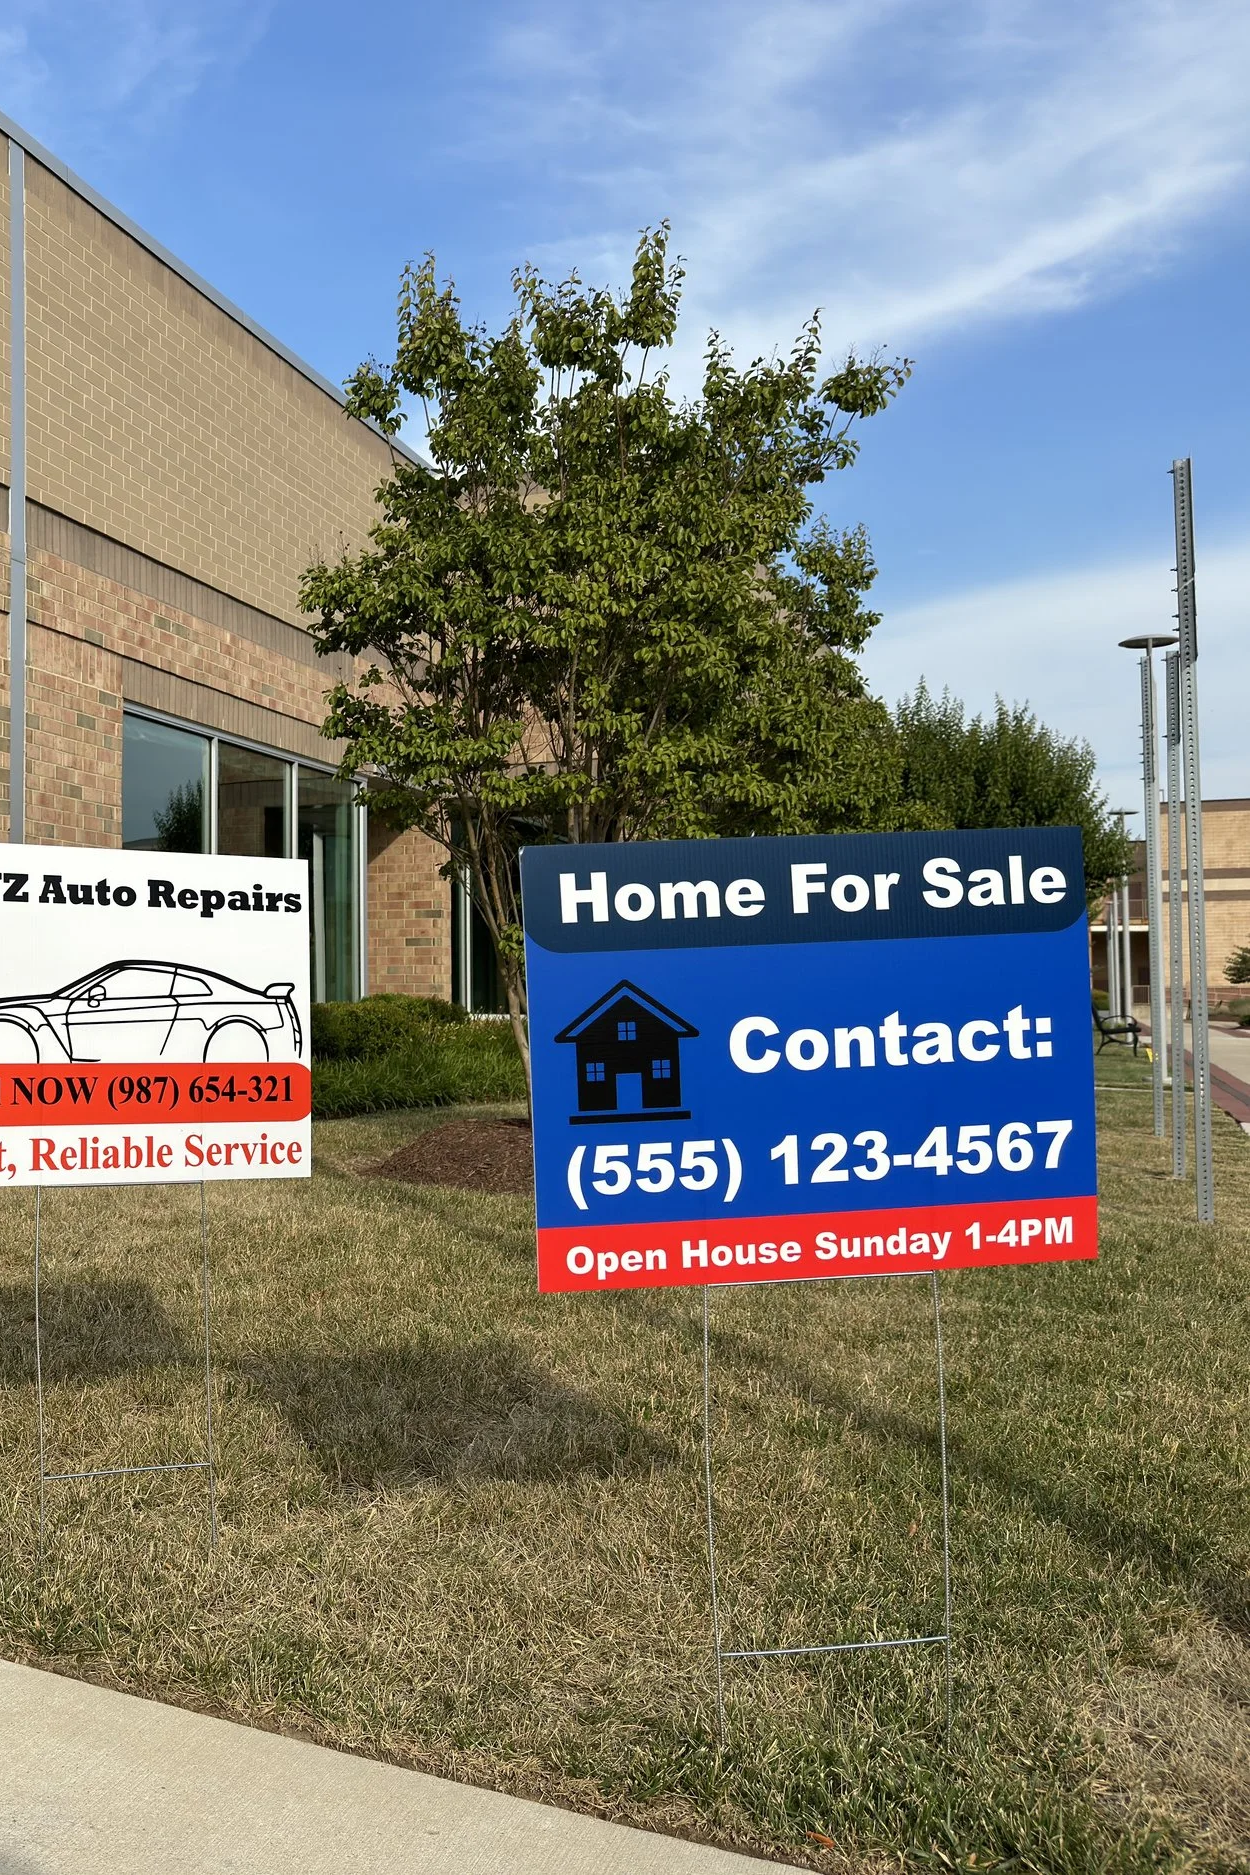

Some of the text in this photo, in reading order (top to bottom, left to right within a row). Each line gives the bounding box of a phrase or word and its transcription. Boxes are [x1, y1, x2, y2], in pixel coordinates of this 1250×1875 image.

[39, 875, 136, 906] Auto
[148, 880, 301, 918] Repairs
[560, 856, 1066, 923] Home For Sale
[730, 1005, 1052, 1073] Contact:
[12, 1078, 97, 1104] NOW
[108, 1077, 179, 1110] (987)
[189, 1076, 292, 1102] 654-321
[29, 1136, 172, 1170] Reliable
[185, 1133, 302, 1166] Service
[568, 1120, 1072, 1209] (555) 123-4567
[567, 1217, 1072, 1280] Open House Sunday 1-4PM
